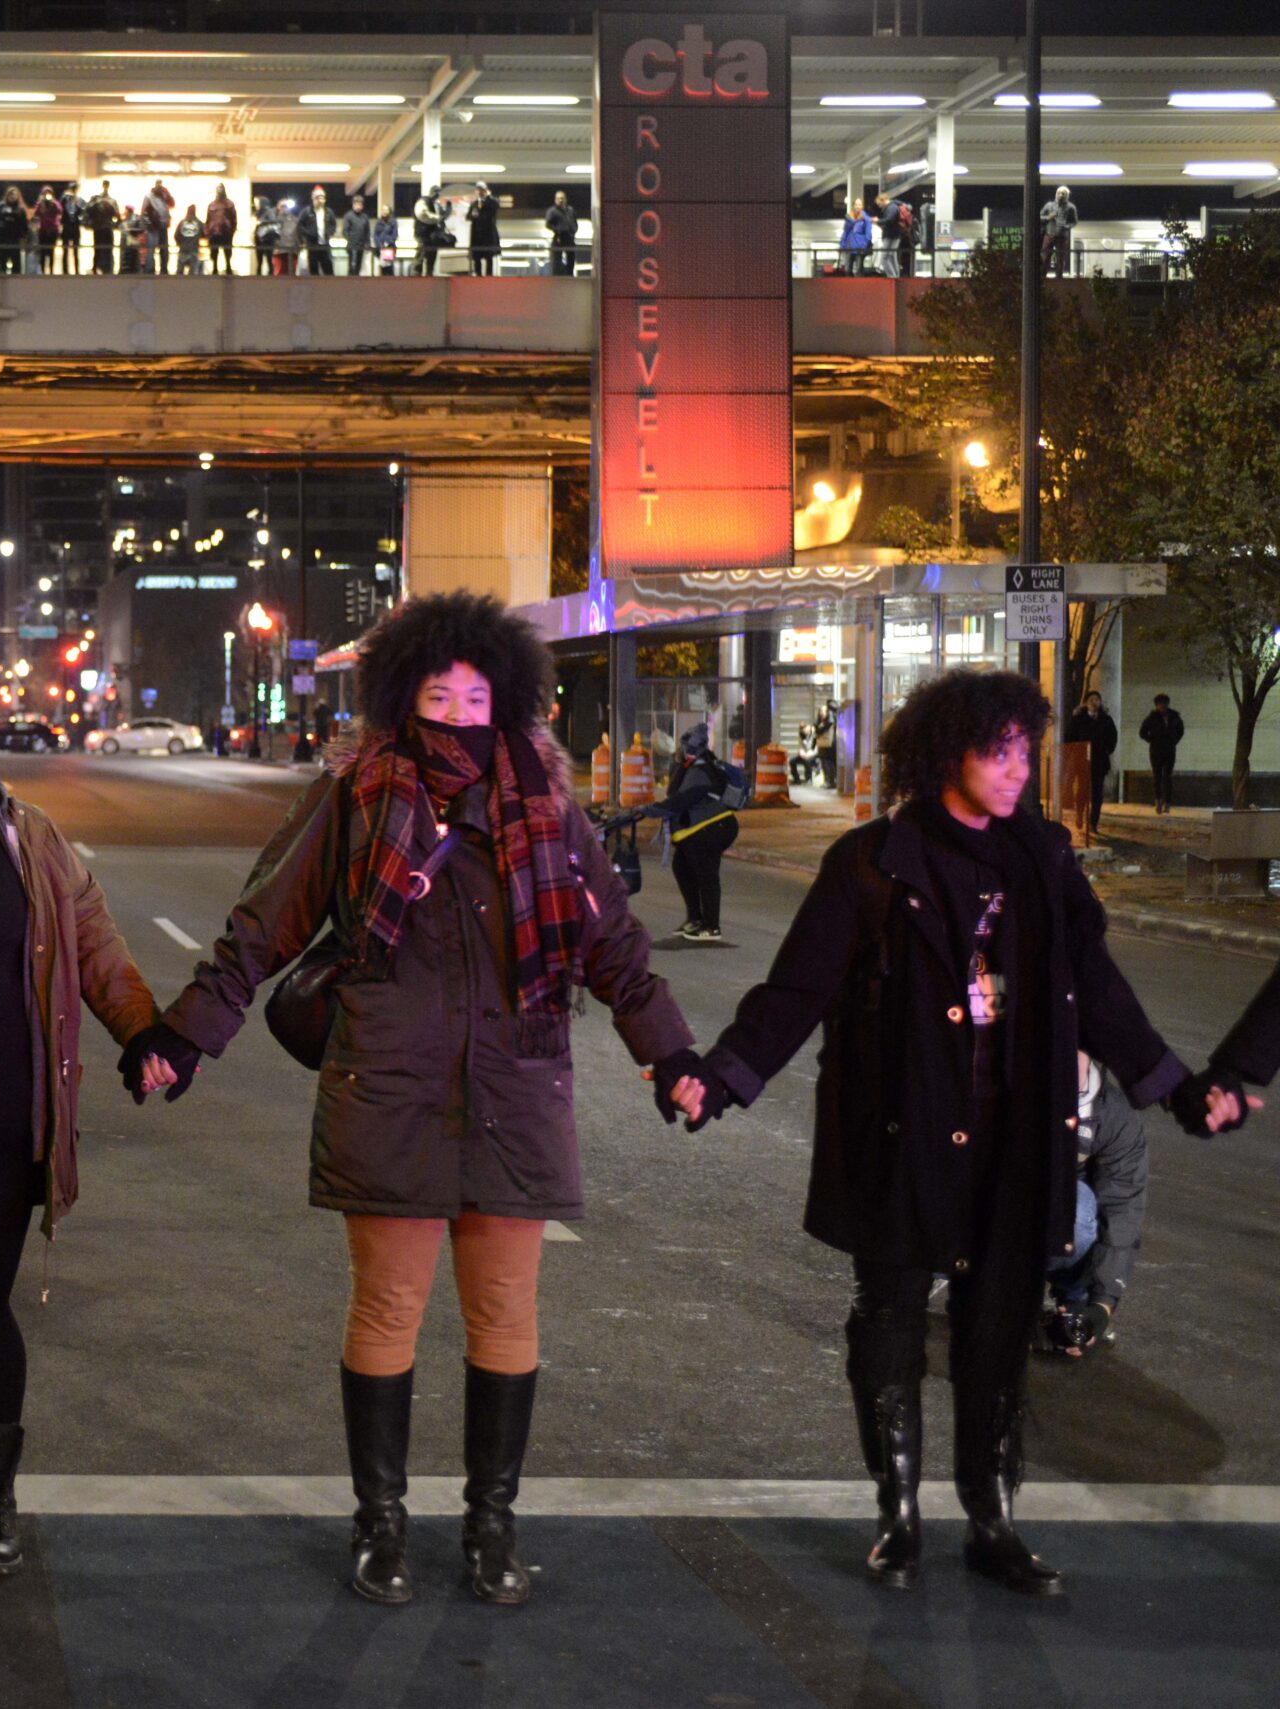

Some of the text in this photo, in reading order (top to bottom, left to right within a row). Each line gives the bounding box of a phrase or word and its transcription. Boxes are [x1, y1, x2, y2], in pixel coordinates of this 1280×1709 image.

[622, 24, 770, 97] cta
[940, 222, 952, 235] R
[635, 115, 661, 526] ROOSEVELT
[1031, 568, 1061, 579] RIGHT
[1032, 579, 1060, 589] LANE
[1012, 594, 1058, 604] BUSES &
[1021, 604, 1050, 614] RIGHT
[1019, 615, 1053, 625] TURNS
[1022, 625, 1048, 635] ONLY
